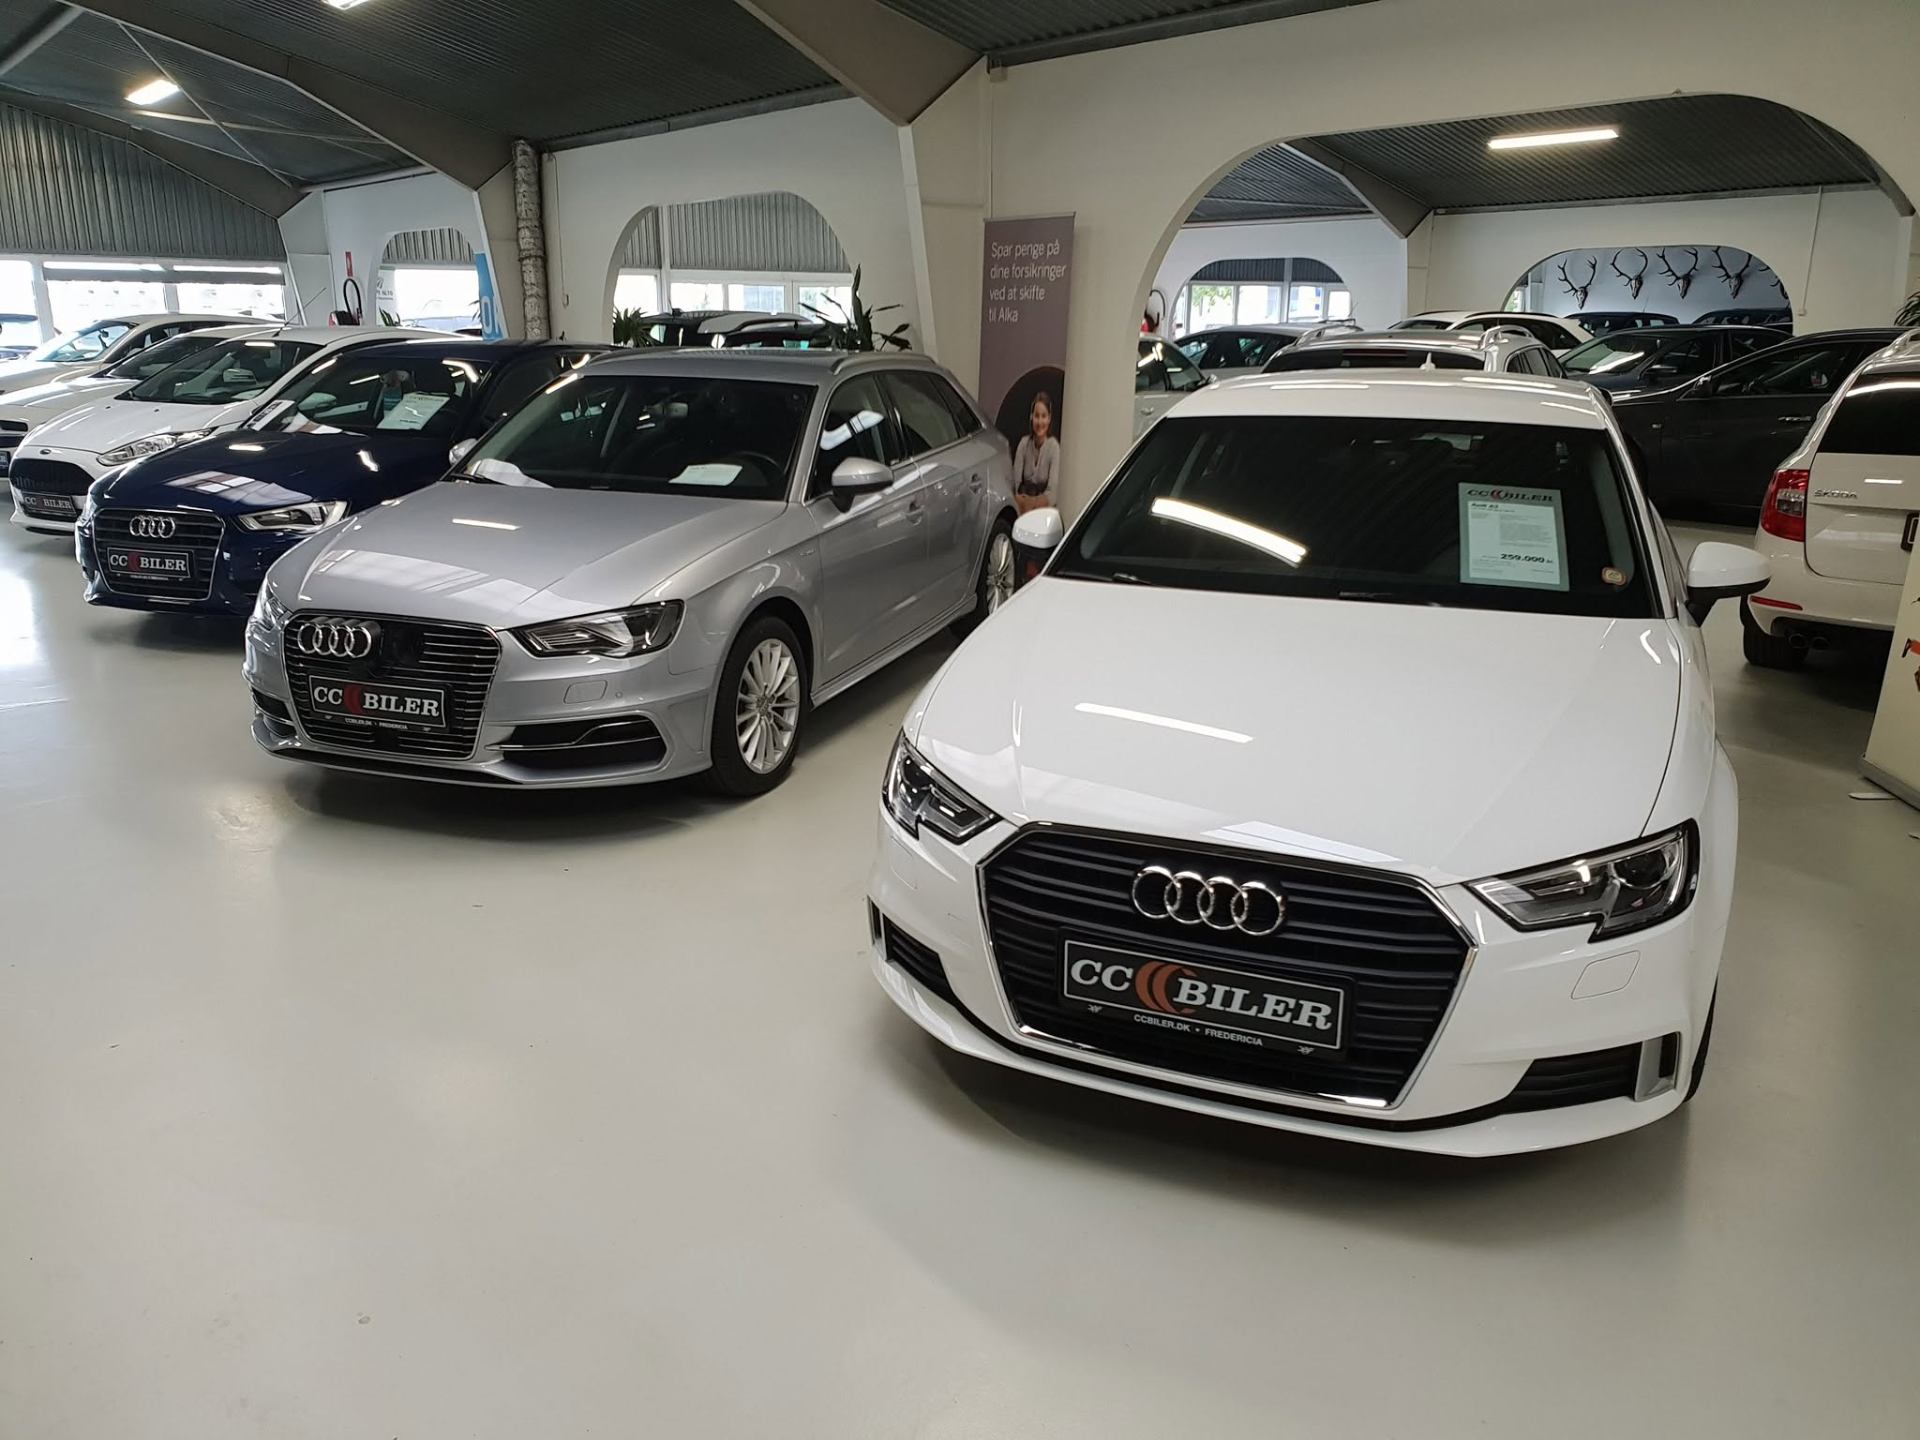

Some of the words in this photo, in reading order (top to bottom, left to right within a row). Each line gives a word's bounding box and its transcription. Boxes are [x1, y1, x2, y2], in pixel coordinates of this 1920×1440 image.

[991, 241, 1012, 260] Spar
[1014, 242, 1045, 259] penge
[1047, 239, 1060, 259] på
[990, 264, 1009, 279] dine
[1011, 263, 1066, 281] forsikringer
[989, 286, 1006, 300] ved
[1007, 287, 1017, 300] at
[1019, 285, 1045, 300] skifte
[988, 308, 996, 322] til
[998, 307, 1019, 322] Alka
[43, 499, 72, 508] BILER
[109, 554, 128, 567] CC
[140, 555, 187, 572] BILER
[313, 686, 343, 705] CC
[363, 692, 440, 717] BILER
[1070, 959, 1134, 992] CC
[1173, 976, 1333, 1031] BILER
[1133, 1013, 1191, 1033] CCBILER.DK
[1204, 1027, 1263, 1046] FREDERICIA
